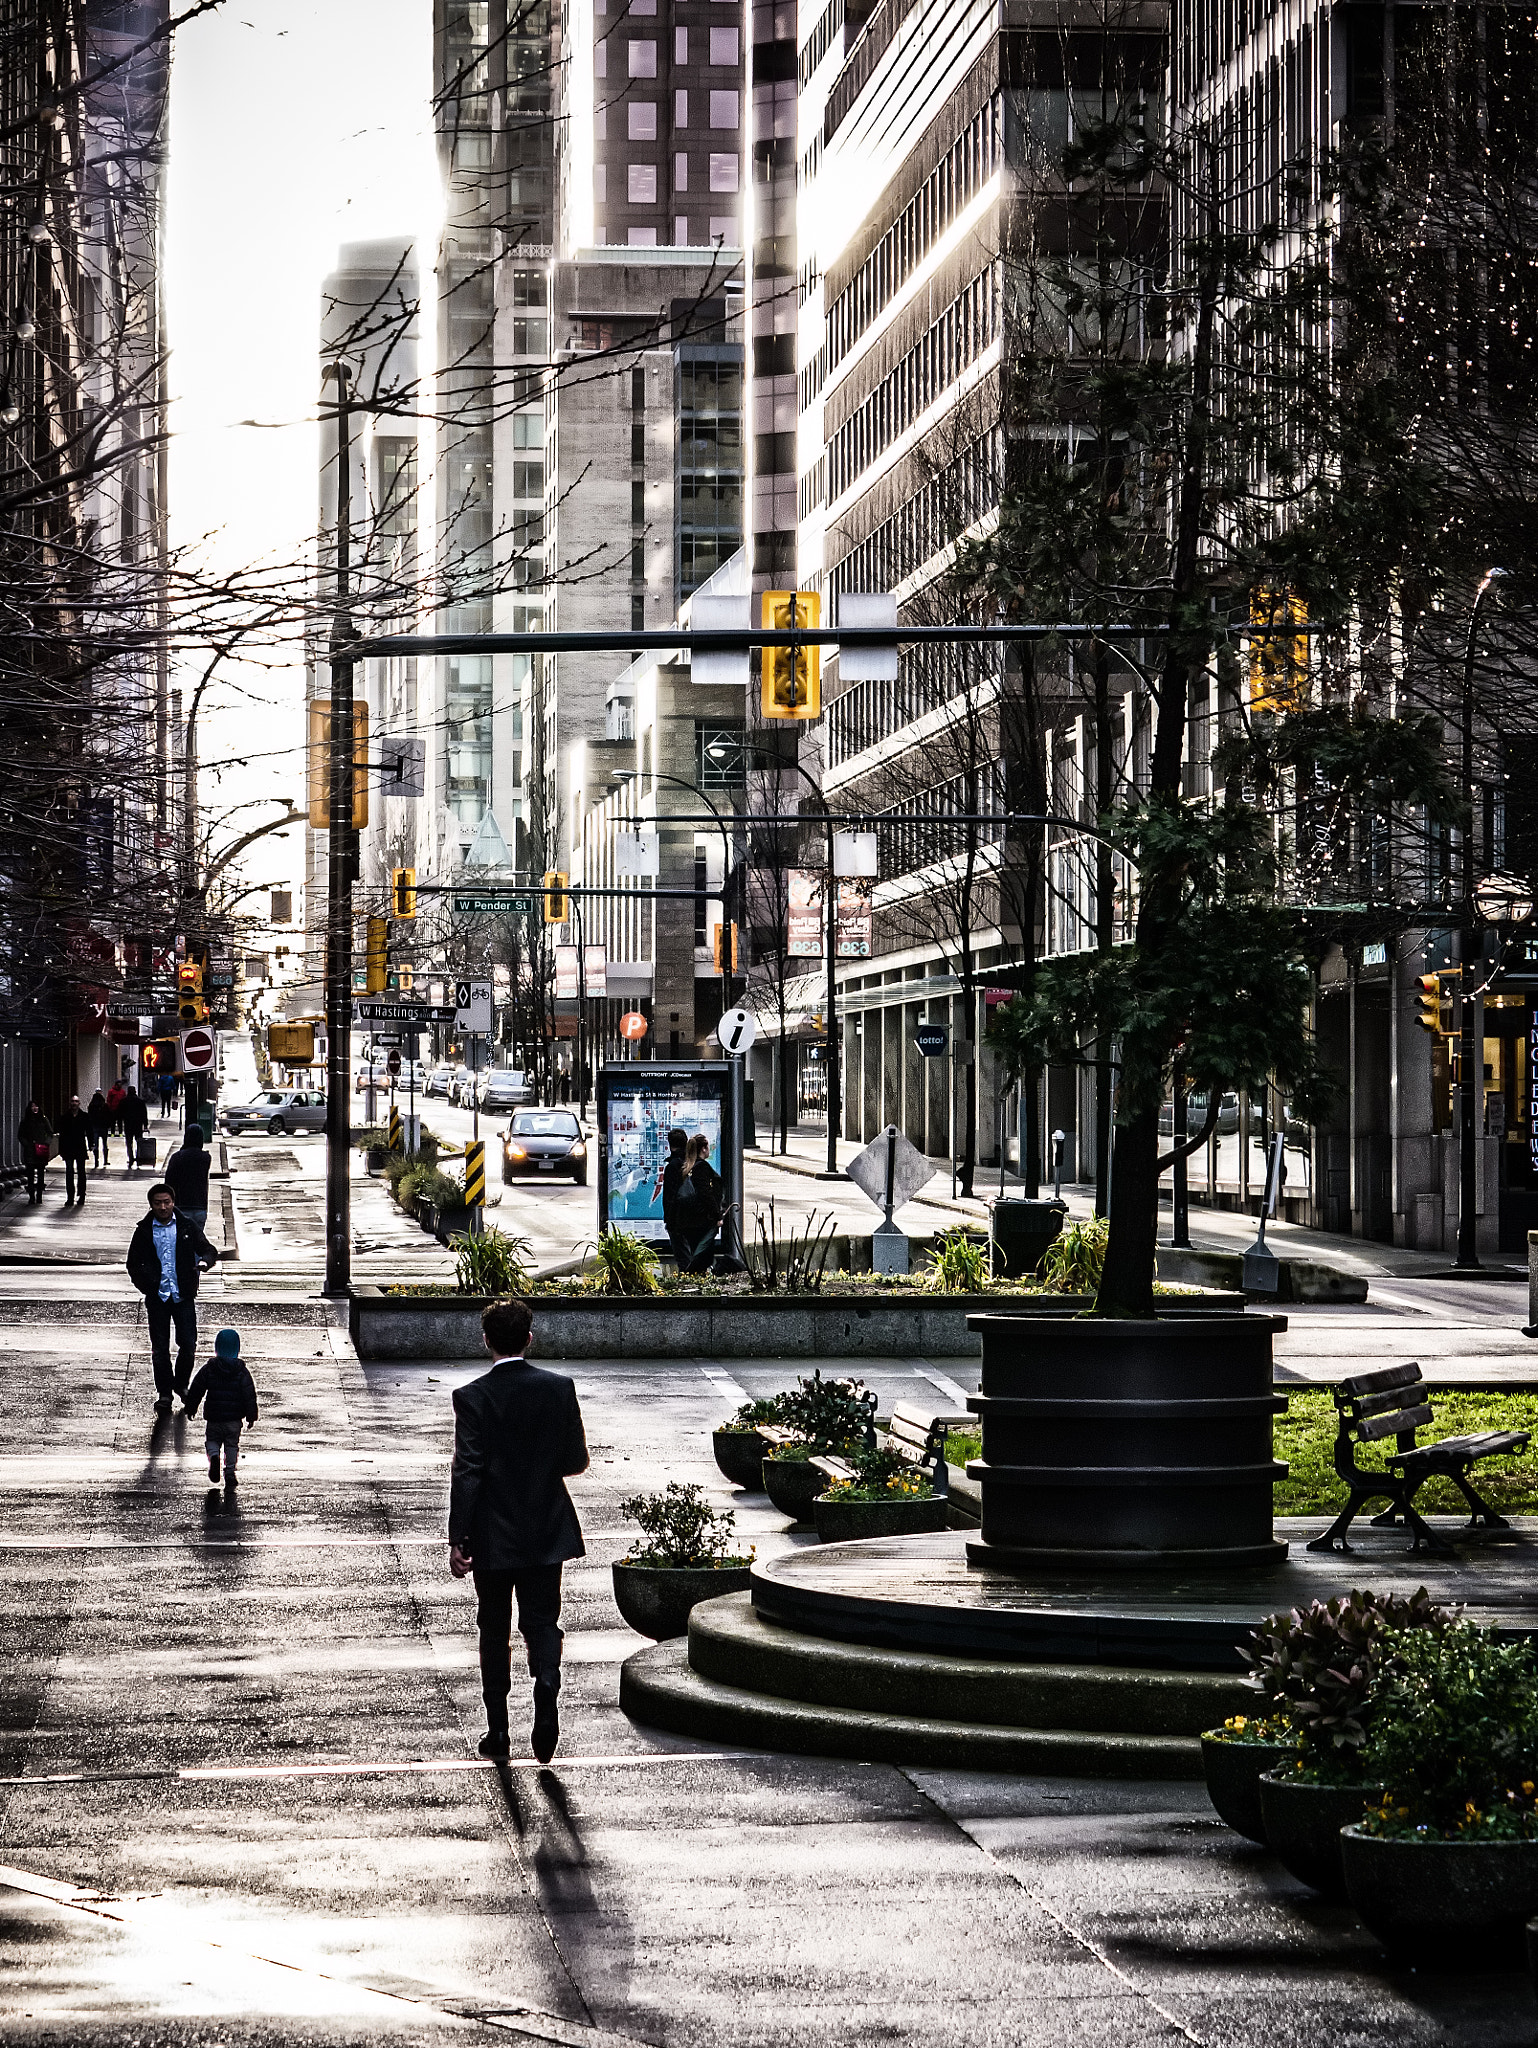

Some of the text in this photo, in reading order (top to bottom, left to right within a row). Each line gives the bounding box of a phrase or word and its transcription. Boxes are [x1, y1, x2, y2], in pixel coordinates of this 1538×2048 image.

[460, 901, 527, 910] W Pender St
[108, 1006, 151, 1015] W Hastings
[362, 1006, 371, 1016] W
[375, 1006, 419, 1019] Hastings
[627, 1016, 641, 1036] P
